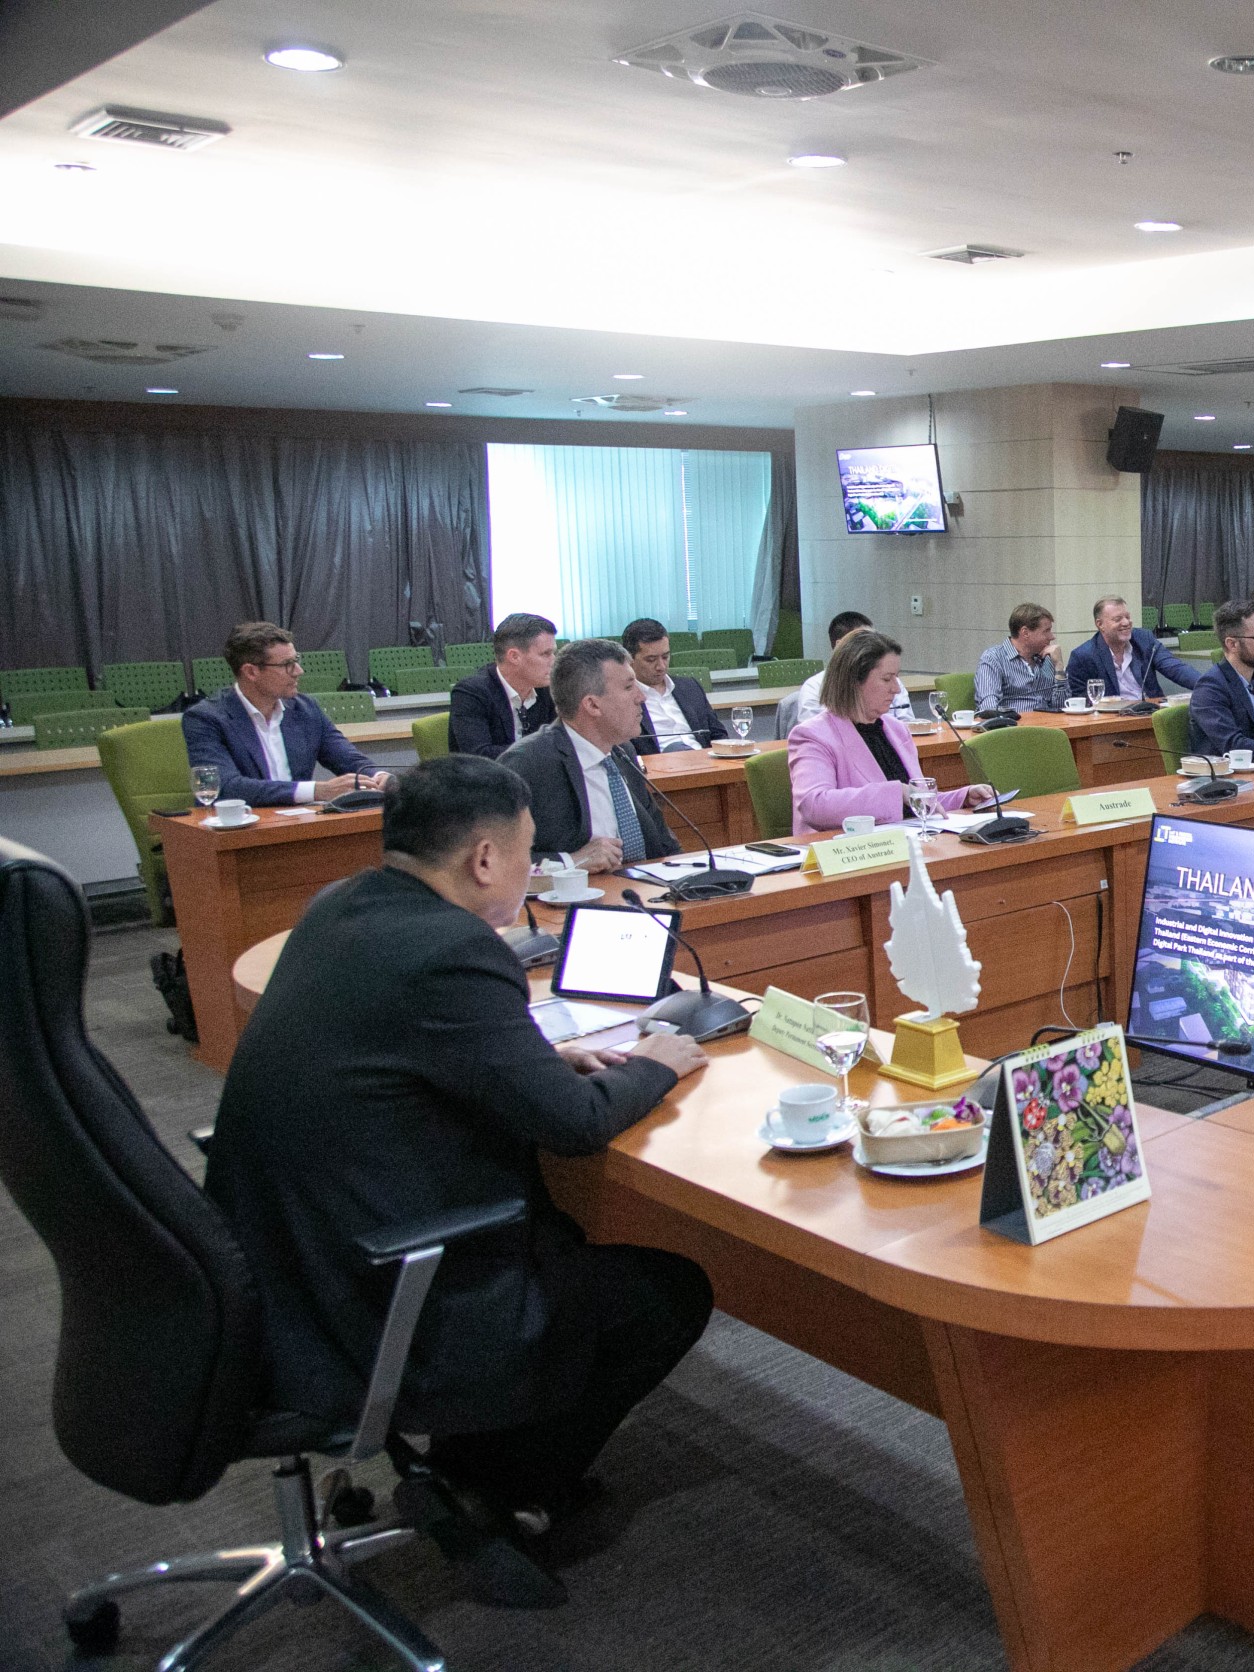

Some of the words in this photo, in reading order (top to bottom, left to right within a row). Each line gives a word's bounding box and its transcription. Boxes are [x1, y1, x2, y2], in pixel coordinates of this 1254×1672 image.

[1099, 799, 1132, 811] Austrade
[832, 848, 845, 856] Mr.
[845, 844, 867, 853] Xavier
[867, 839, 894, 849] Simonet,
[841, 855, 858, 864] CEO
[858, 853, 866, 861] of
[867, 849, 894, 859] Austrade
[1155, 916, 1185, 930] Industrial
[1185, 922, 1198, 932] and
[1197, 925, 1219, 936] Digital
[1219, 929, 1254, 943] Innovation
[1155, 927, 1181, 940] Thailand
[1181, 932, 1207, 945] (Eastern
[1207, 937, 1239, 952] Economic
[1152, 938, 1173, 949] Digital
[1173, 941, 1188, 953] Park
[1188, 945, 1215, 959] Thailand
[1222, 953, 1238, 964] part
[1237, 956, 1246, 965] of
